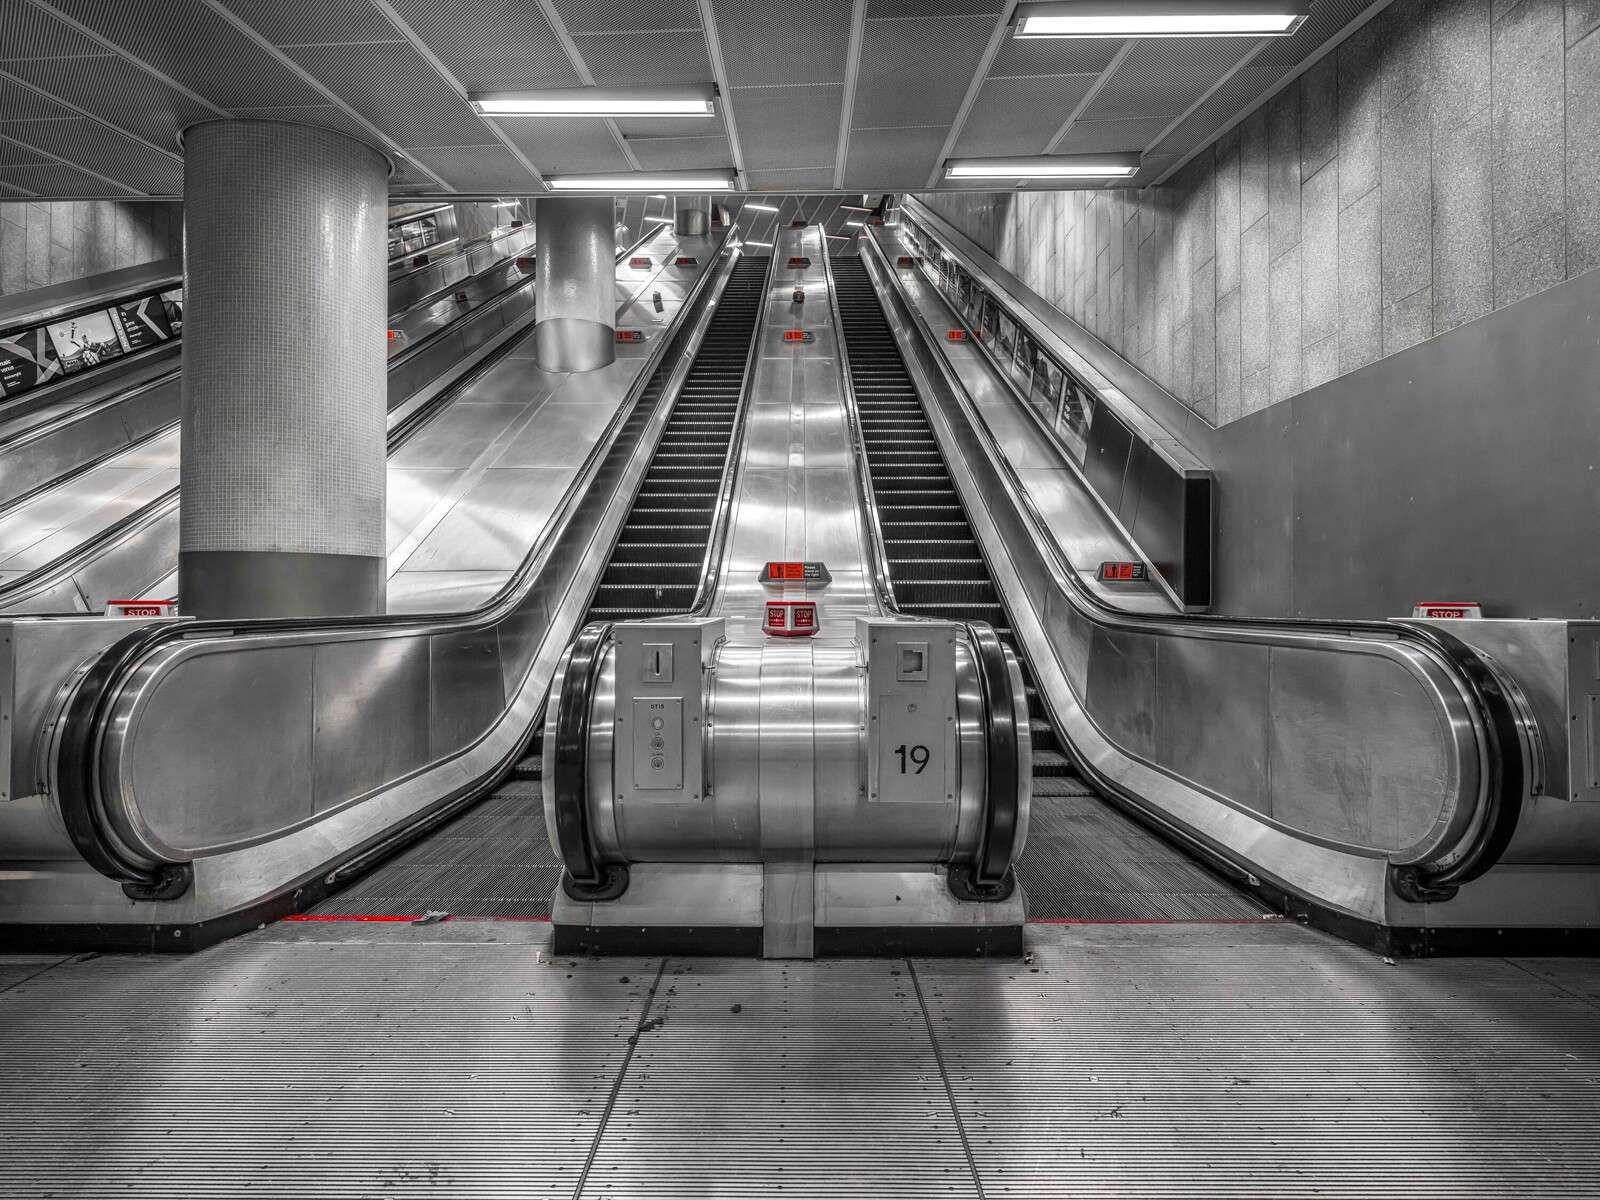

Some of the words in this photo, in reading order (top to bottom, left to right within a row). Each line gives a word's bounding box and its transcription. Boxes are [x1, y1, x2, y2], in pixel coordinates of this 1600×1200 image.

[128, 609, 157, 617] STOP
[769, 609, 784, 618] STOP
[796, 610, 812, 618] STOP
[894, 744, 930, 775] 19
